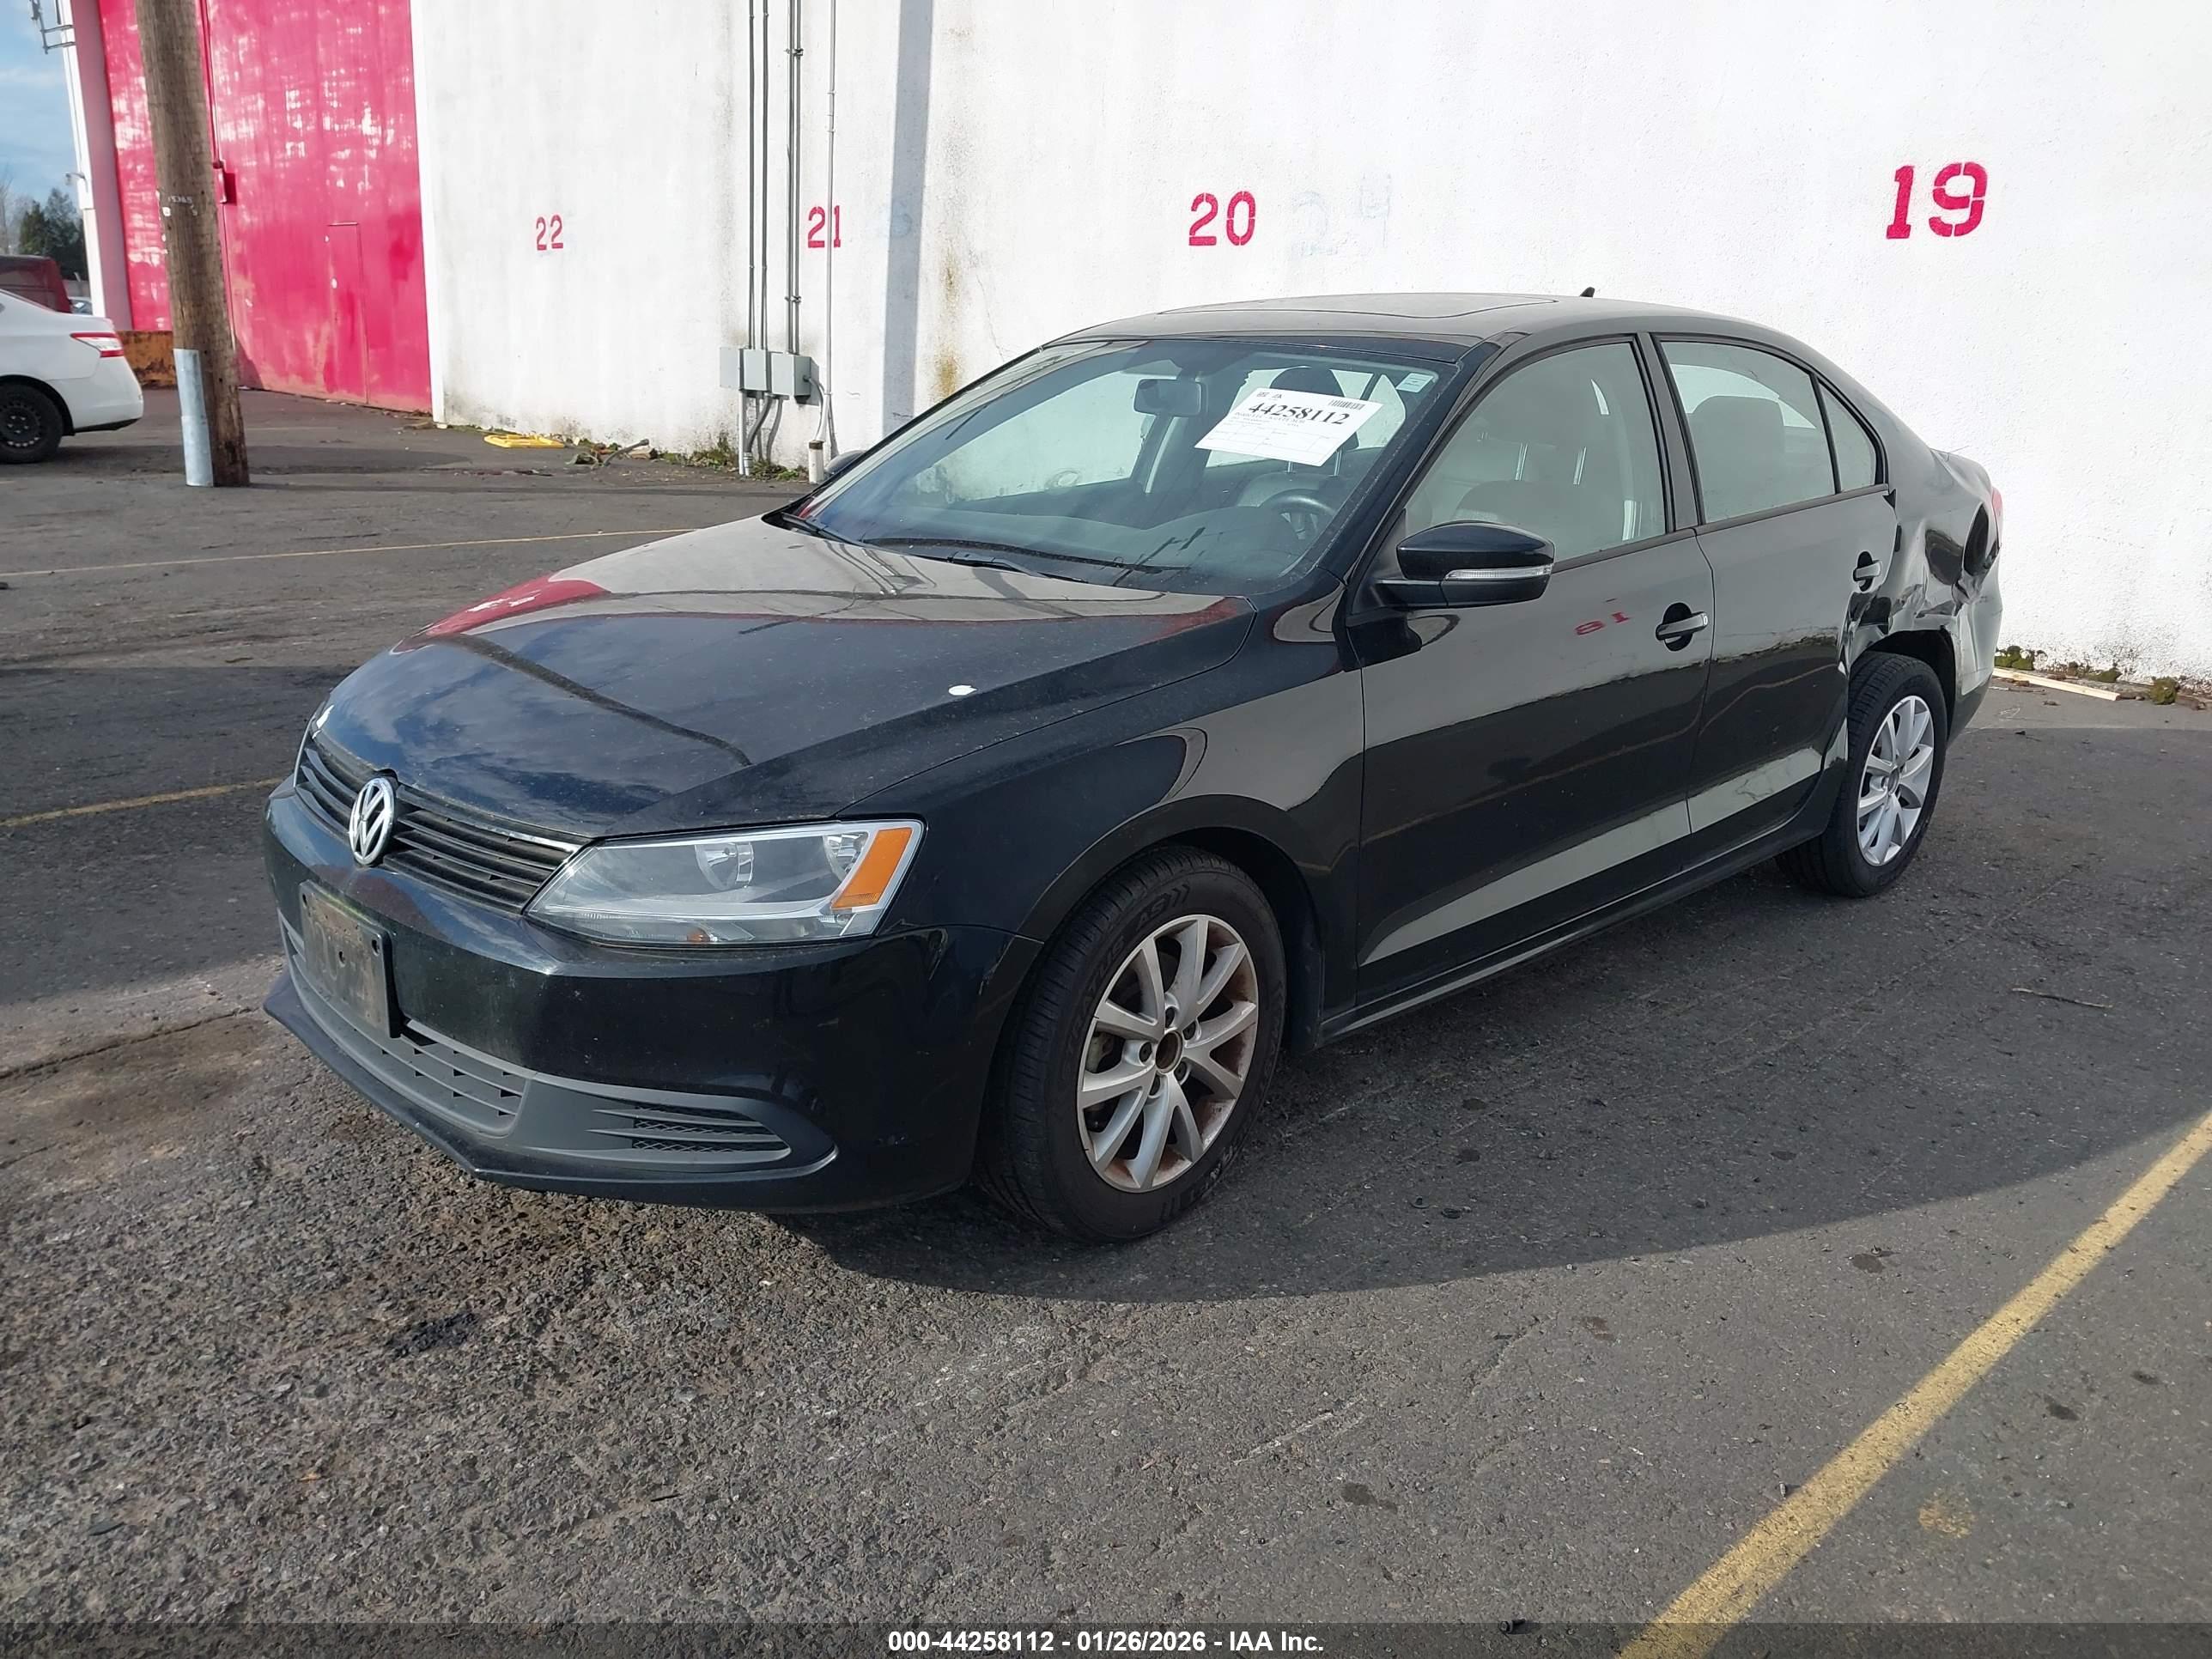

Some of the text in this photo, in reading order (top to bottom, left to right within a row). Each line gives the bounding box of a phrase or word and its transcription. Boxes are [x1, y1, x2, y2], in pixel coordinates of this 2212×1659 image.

[1188, 191, 1256, 247] 20
[1886, 161, 1989, 240] 19
[536, 215, 563, 250] 22
[807, 205, 841, 248] 21
[1249, 402, 1351, 425] 44258112
